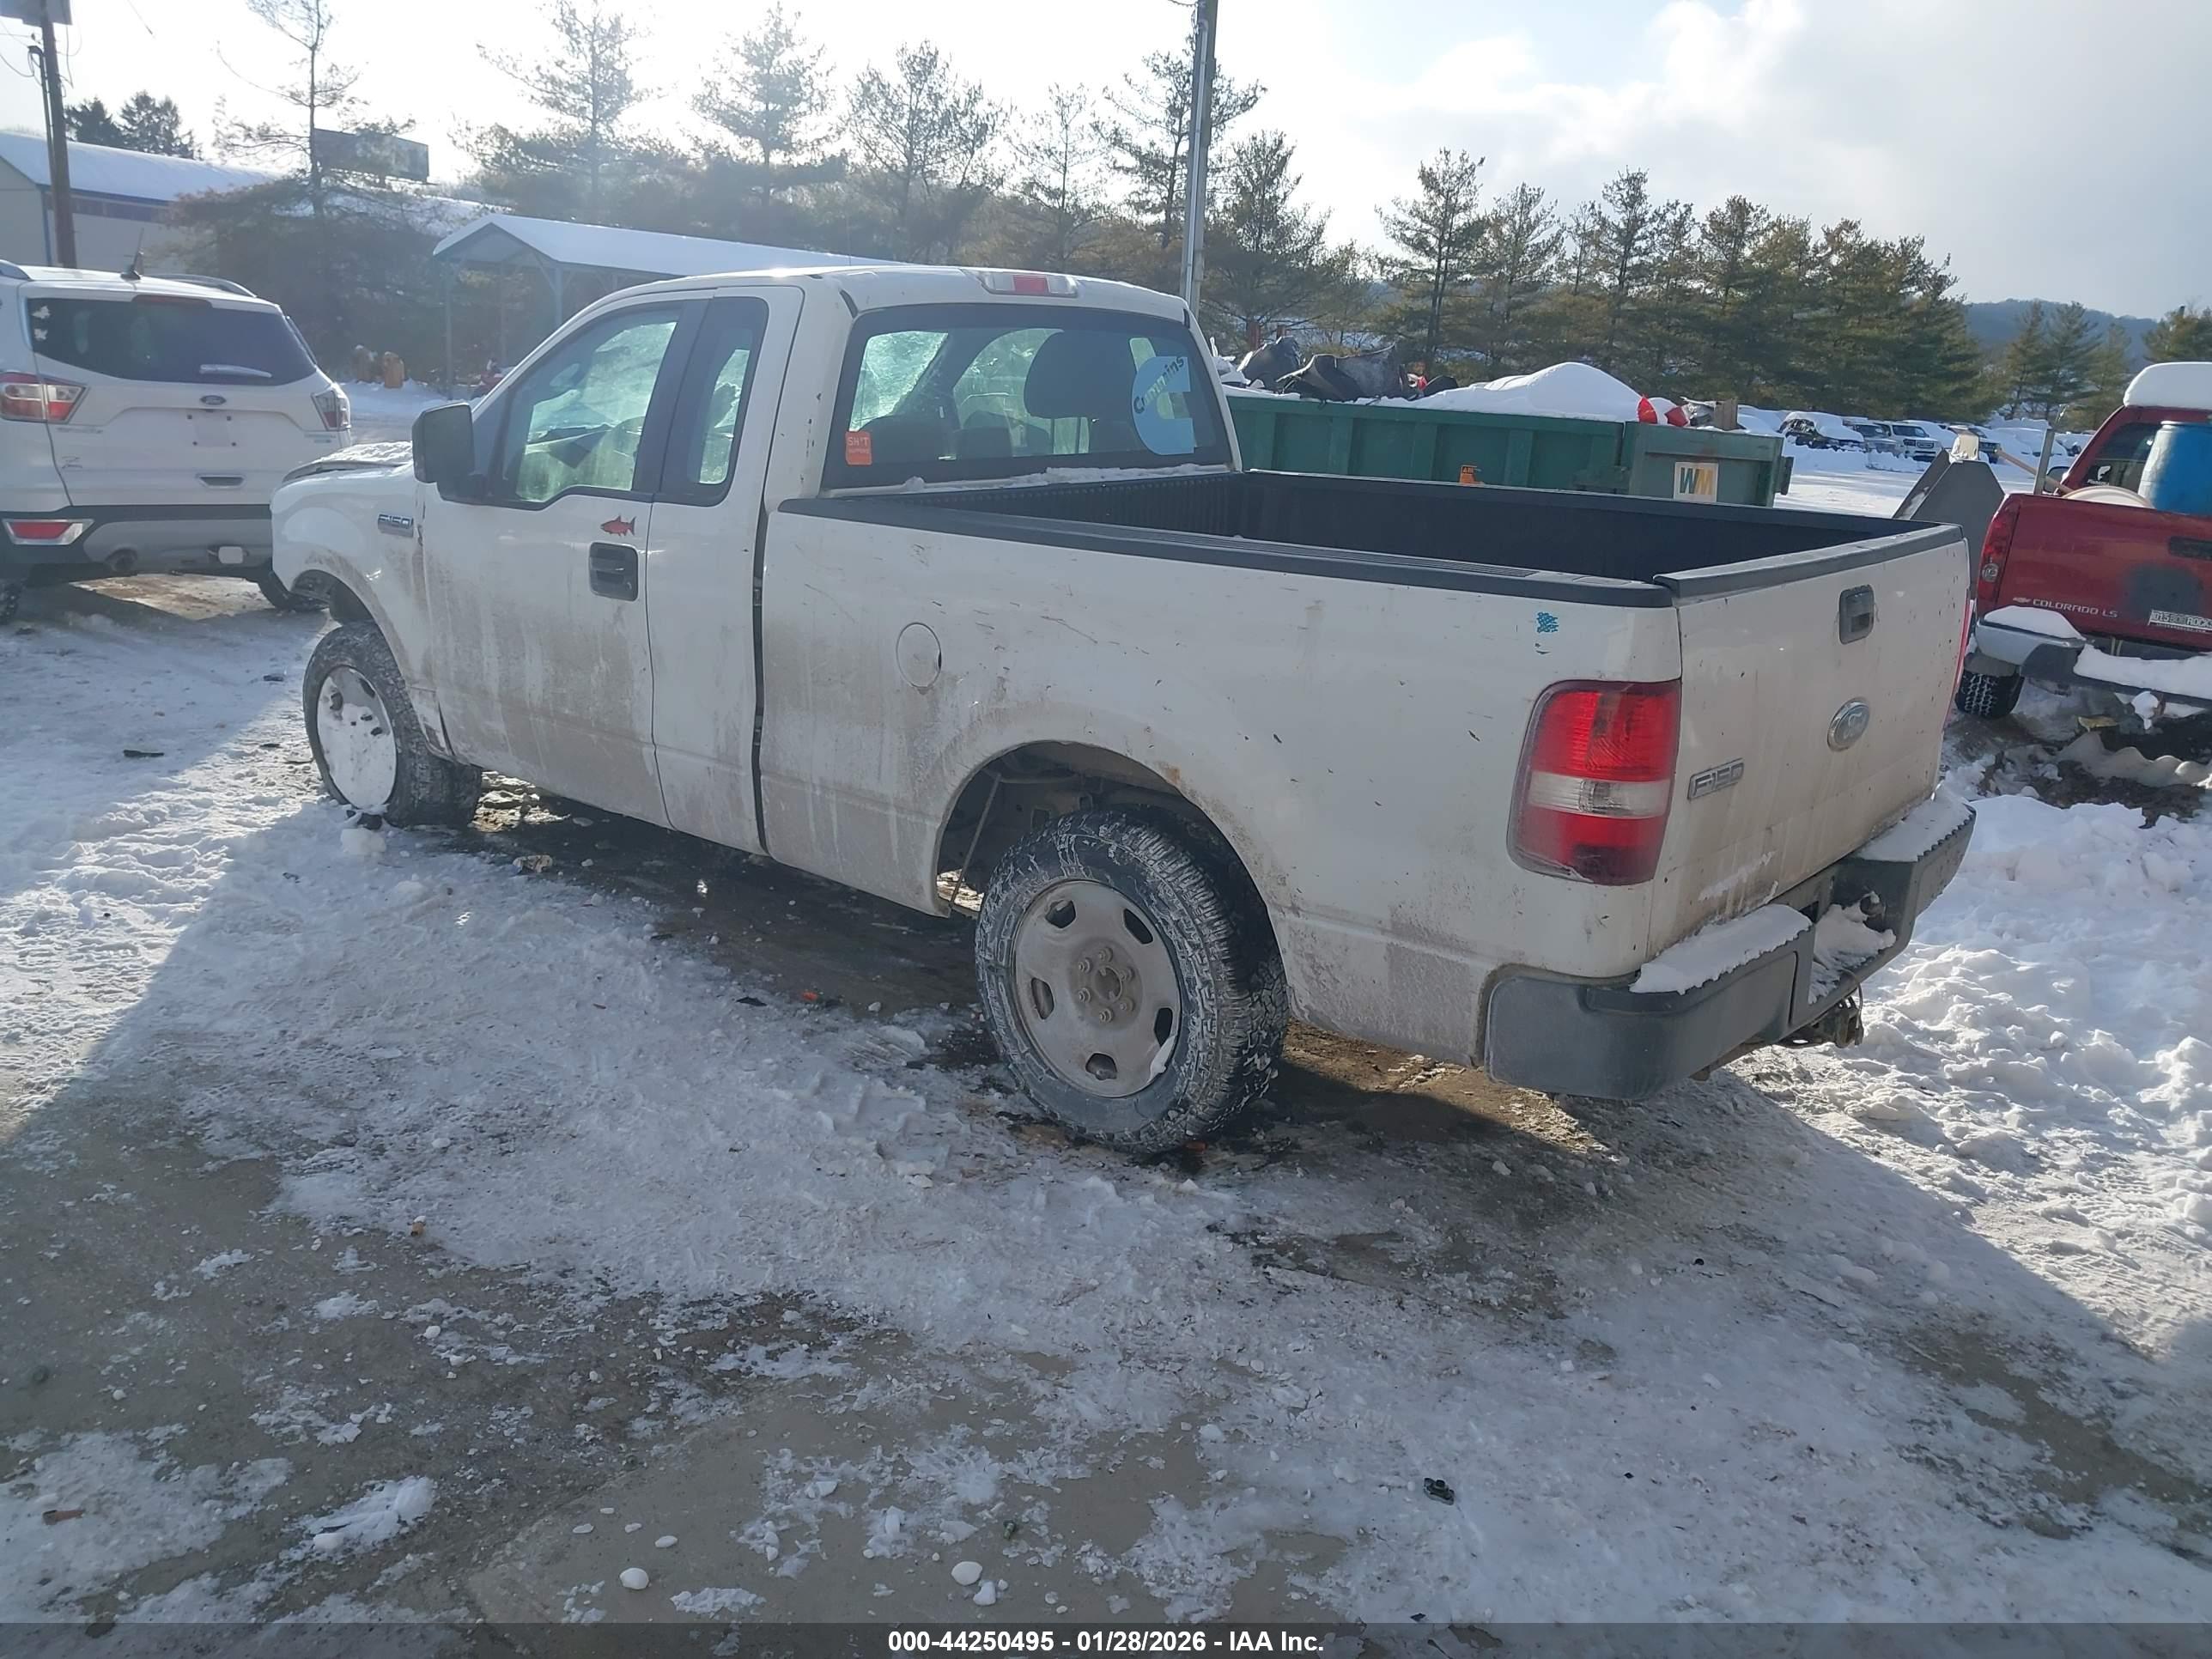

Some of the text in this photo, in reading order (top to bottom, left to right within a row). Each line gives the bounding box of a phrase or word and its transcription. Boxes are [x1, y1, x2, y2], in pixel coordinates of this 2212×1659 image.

[1133, 356, 1185, 414] Cummins
[1679, 466, 1714, 495] WM
[2033, 599, 2118, 618] COLORADO LS
